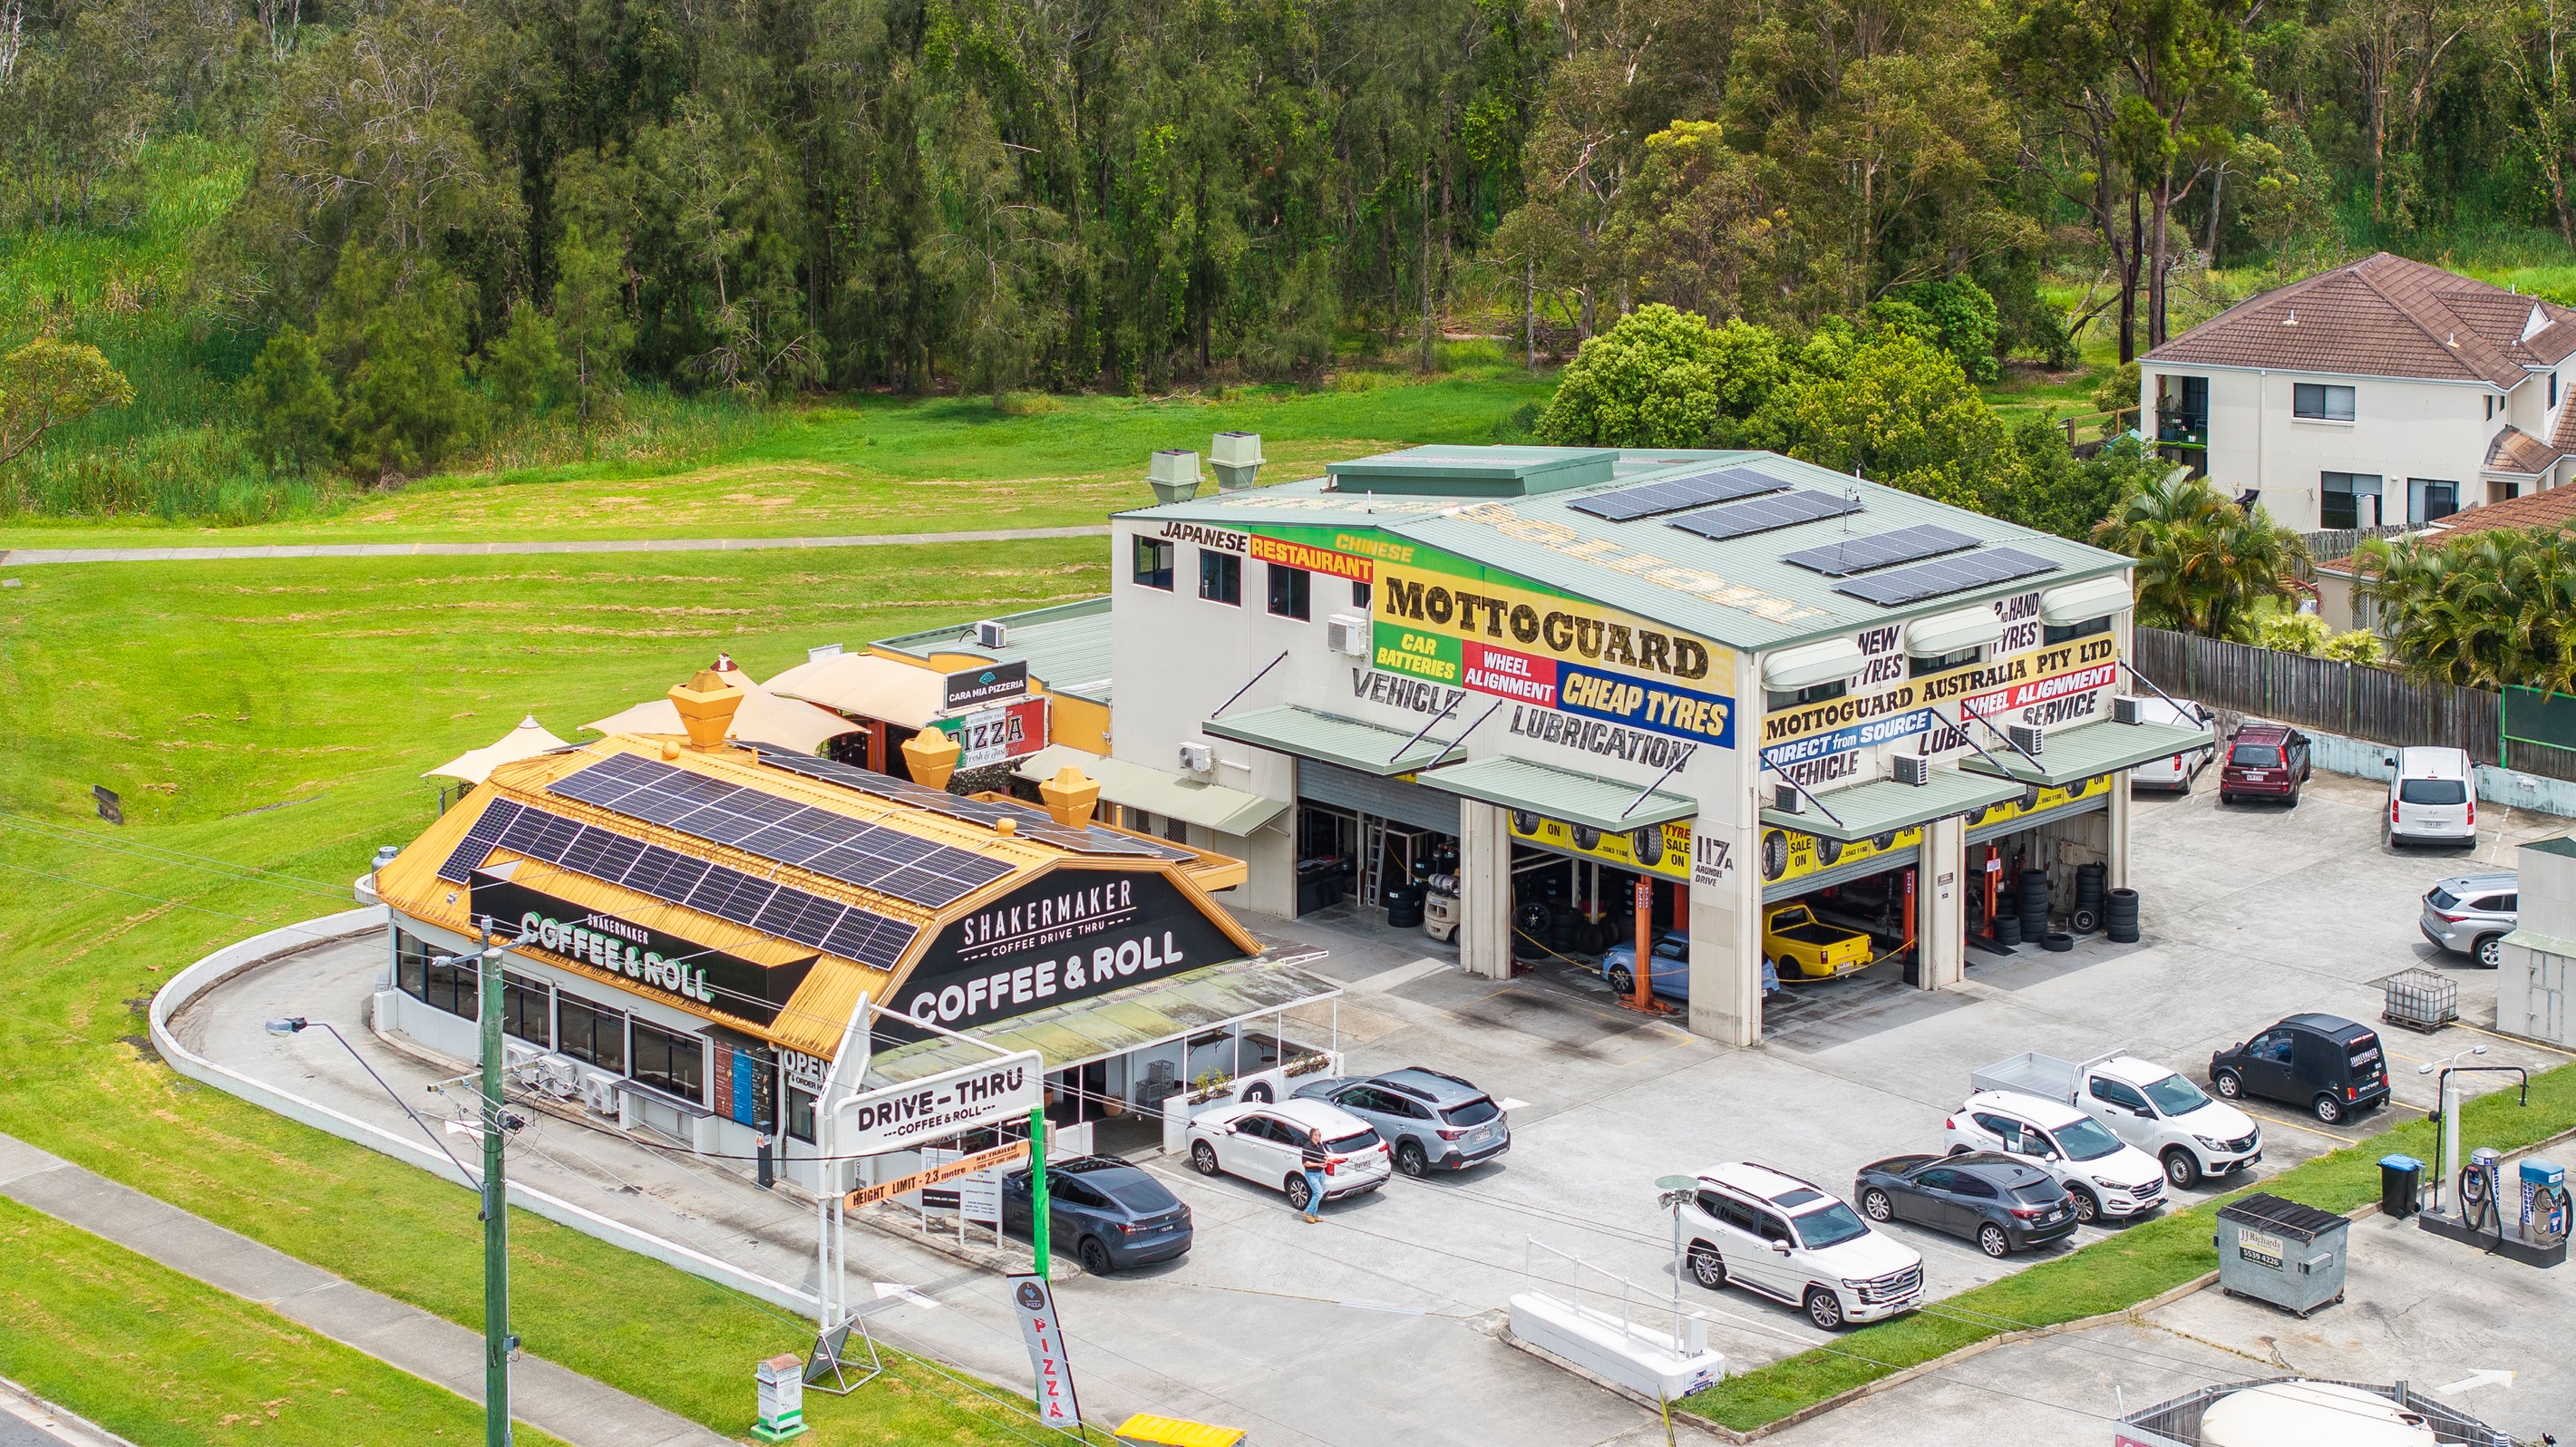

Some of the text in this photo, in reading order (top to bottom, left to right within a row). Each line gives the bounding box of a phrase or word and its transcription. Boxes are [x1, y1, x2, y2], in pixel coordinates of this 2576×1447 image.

[1160, 521, 1248, 553] JAPANESE
[1336, 533, 1414, 563] CHINESE
[1251, 537, 1373, 579] RESTAURANT
[2008, 592, 2040, 621] HAND
[1385, 576, 1709, 680] MOTTOGUARD
[1858, 625, 1900, 656] NEW
[1993, 621, 2038, 655] YRES
[1401, 634, 1437, 656] CAR
[1376, 647, 1456, 680] BATTERIES
[1482, 651, 1532, 678] WHEEL
[1852, 653, 1904, 688] YRES
[949, 679, 1025, 702] CARA MIA PIZZERIA
[1352, 667, 1464, 720] VEHICLE
[1464, 667, 1555, 703] ALIGNMENT
[1765, 638, 2113, 741] MOTTOGUARD AUSTRALIA PTY LTD
[1963, 665, 2114, 719] WHEEL ALIGNMENT
[1561, 672, 1729, 737] CHEAP TYRES
[2022, 690, 2098, 726] SERVICE
[1509, 705, 1695, 772] LUBRICATION
[1764, 710, 1930, 768] DIRECT from SOURCE
[1783, 722, 1971, 787] VEHICLE LUBE
[1547, 823, 1560, 837] ON
[1664, 823, 1690, 840] TYRE
[1666, 838, 1690, 854] SALE
[1790, 838, 1812, 854] SALE
[1671, 853, 1685, 868] ON
[1695, 866, 1723, 879] ARUNDEL
[1794, 853, 1807, 868] ON
[1695, 876, 1717, 888] DRIVE
[963, 879, 1132, 945] SHAKERMAKER
[587, 913, 649, 945] SHAKERMAKER
[991, 919, 1105, 957] COFFEE DRIVE THRU
[520, 910, 715, 1003] COFFEE & ROLL
[909, 930, 1184, 1028] COFFEE & ROLL
[783, 1049, 831, 1083] OPEN
[795, 1076, 816, 1090] ORDER
[898, 1104, 982, 1136] COFFEE & ROLL
[852, 1186, 885, 1206] HEIGHT
[892, 1177, 917, 1195] LIMIT
[925, 1170, 939, 1185] 2.3
[2250, 1231, 2280, 1248] Richards
[2243, 1248, 2260, 1260] 5539
[2261, 1255, 2280, 1266] 4226
[1033, 1317, 1064, 1418] PIZZA
